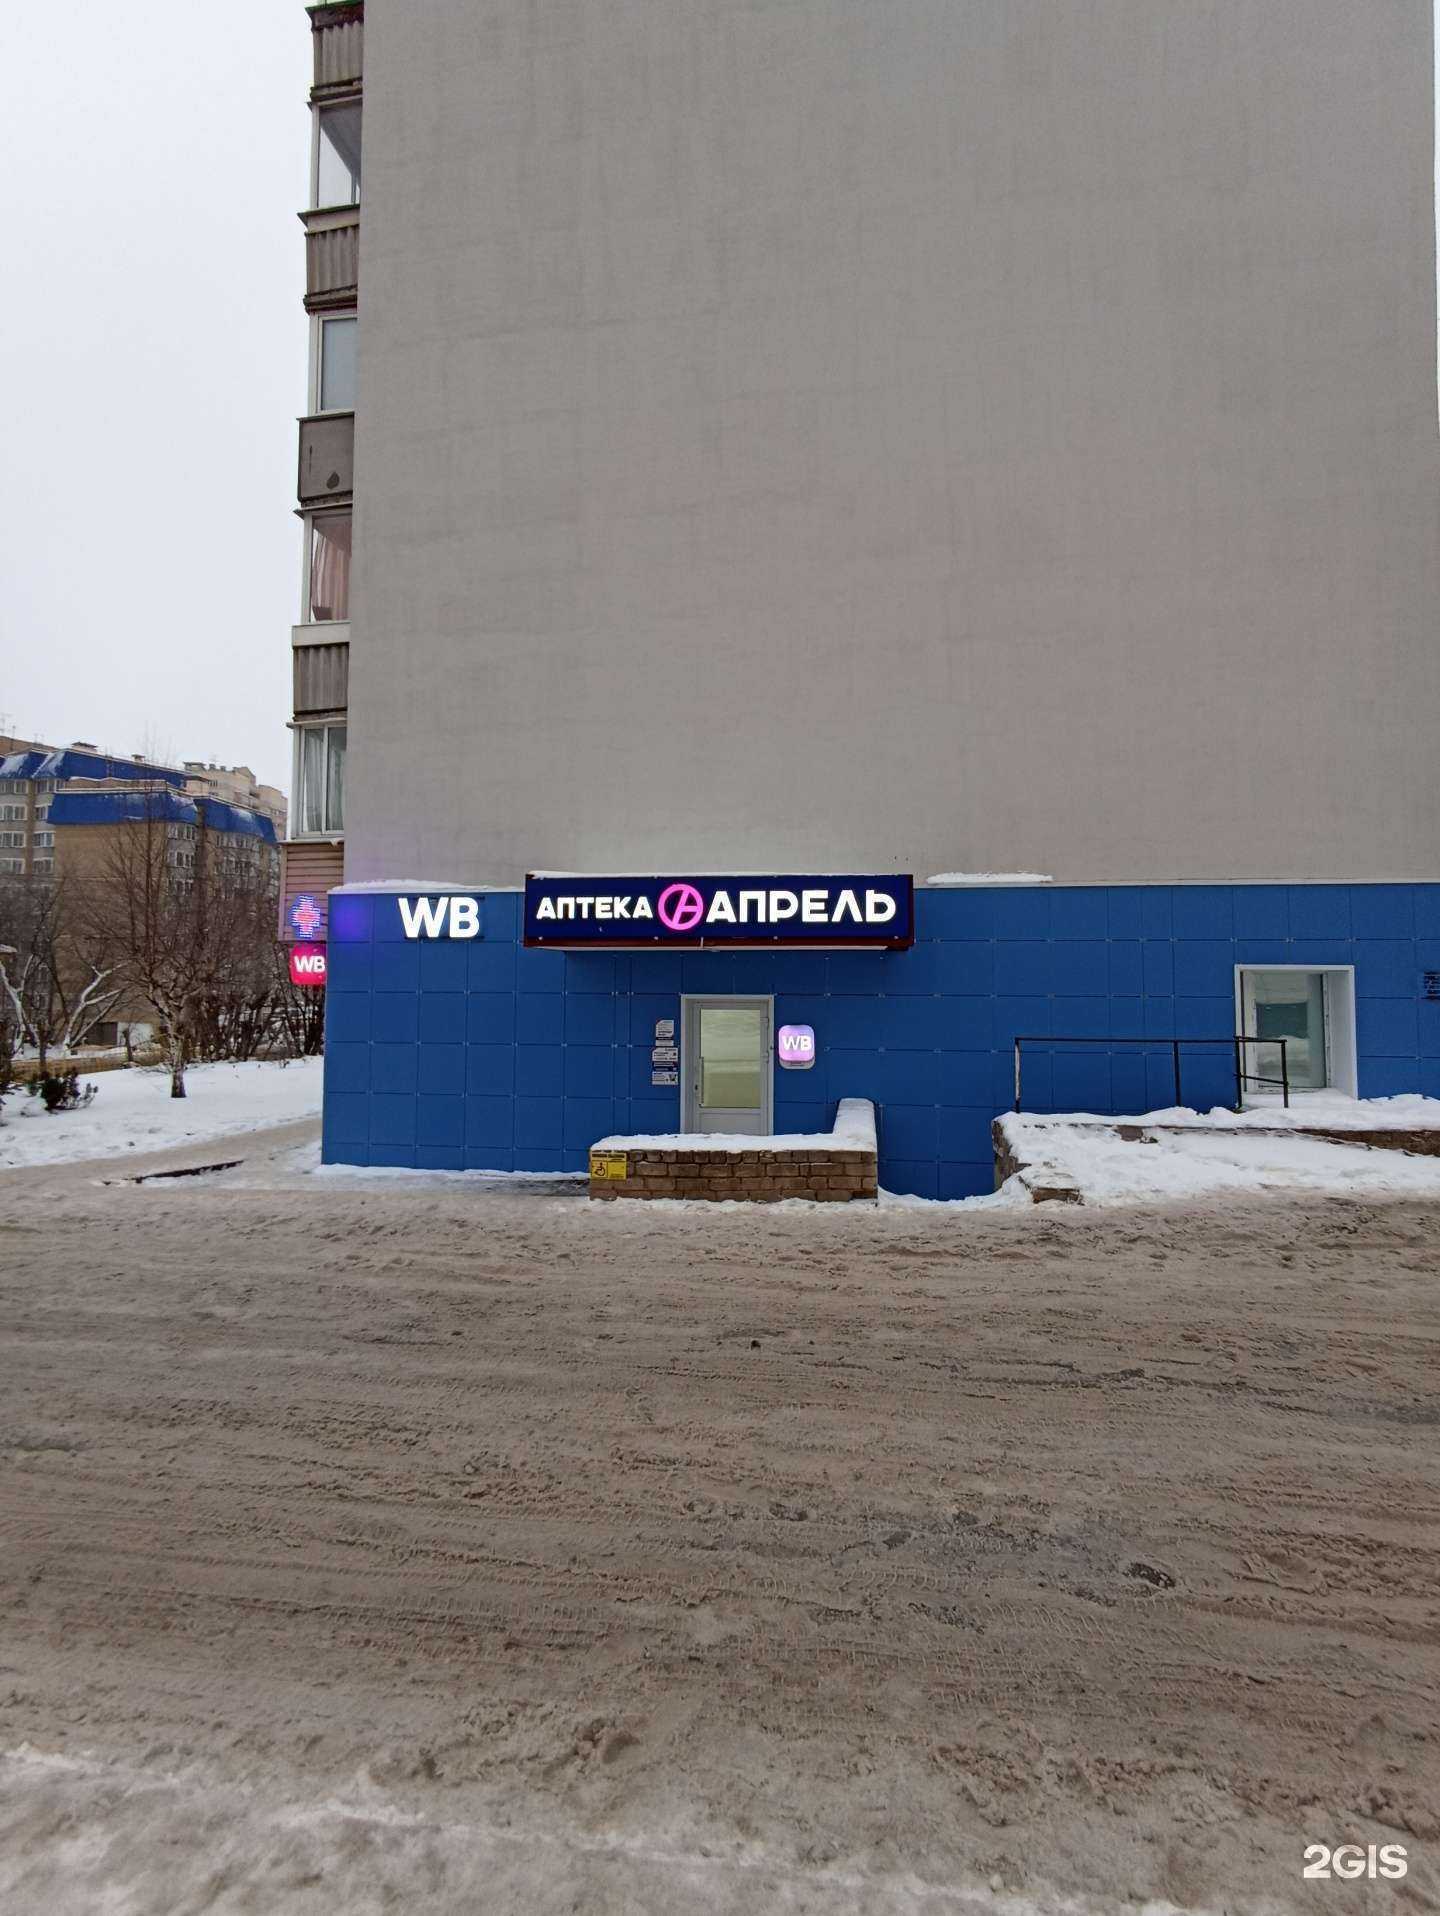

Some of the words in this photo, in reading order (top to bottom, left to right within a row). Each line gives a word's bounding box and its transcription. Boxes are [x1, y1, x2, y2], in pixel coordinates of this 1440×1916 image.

[398, 896, 480, 938] WB
[535, 896, 654, 920] АПТЕКА
[705, 889, 897, 923] АПРЕЛЬ
[293, 955, 326, 973] WB
[782, 1035, 812, 1051] WB
